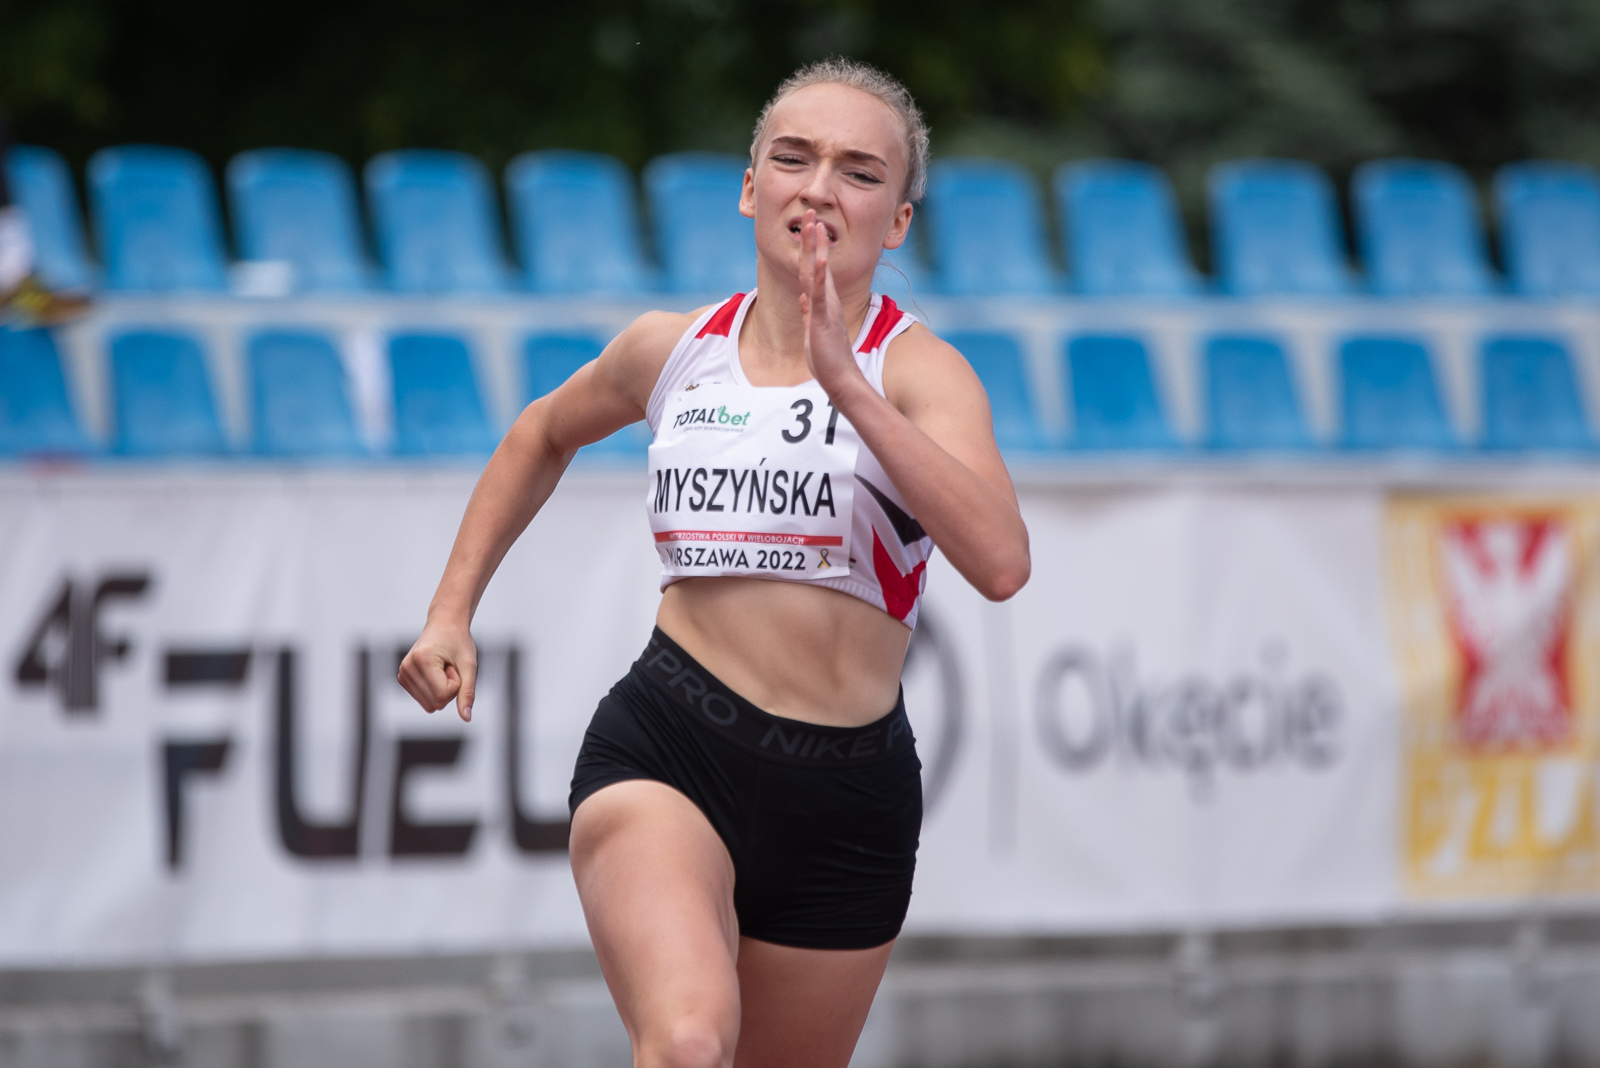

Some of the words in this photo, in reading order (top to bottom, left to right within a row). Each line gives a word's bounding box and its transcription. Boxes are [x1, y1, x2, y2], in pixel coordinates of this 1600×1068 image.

[672, 405, 751, 429] TOTALbet
[781, 398, 839, 446] 31
[654, 458, 836, 518] MYSZYŃSKA
[669, 531, 710, 541] TRZOSTWA
[711, 533, 737, 542] POLSKI
[738, 533, 746, 542] W
[747, 534, 805, 545] WIELOBOJACH
[756, 549, 806, 571] 2022
[646, 649, 738, 727] PRO
[758, 723, 882, 760] NIKE
[160, 643, 571, 874] FUEL
